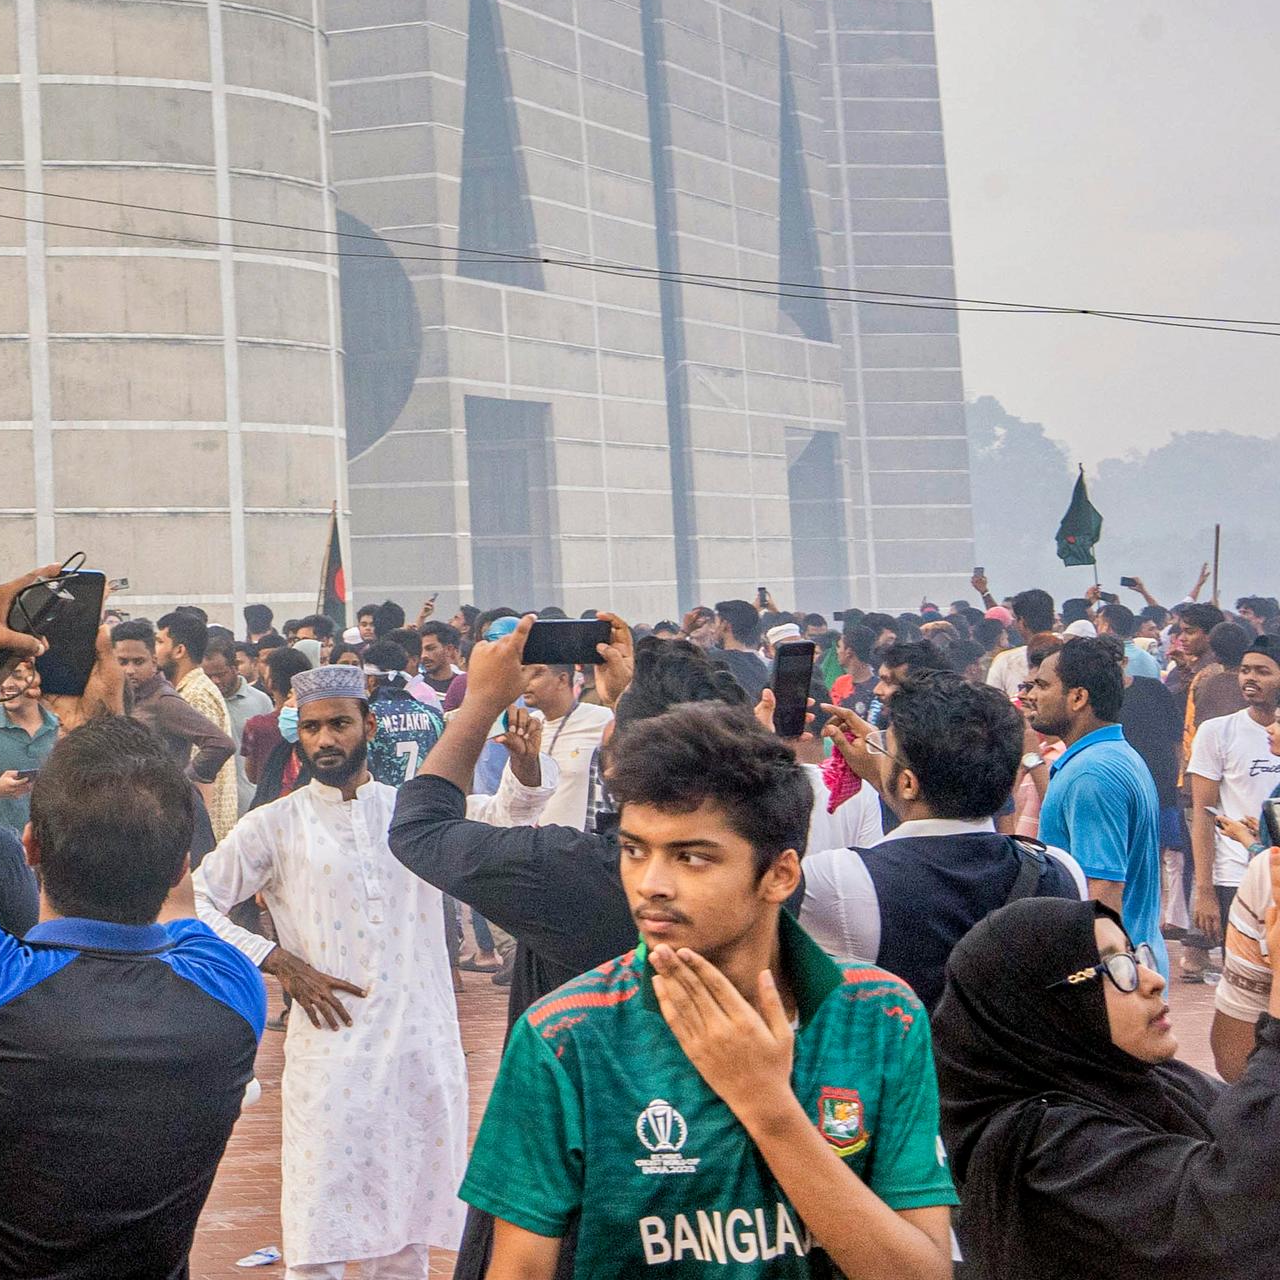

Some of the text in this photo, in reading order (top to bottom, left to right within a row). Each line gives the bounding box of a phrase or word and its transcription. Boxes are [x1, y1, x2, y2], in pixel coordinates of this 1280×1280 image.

[399, 712, 431, 732] ZAKIR
[395, 740, 420, 782] 7
[640, 1202, 811, 1265] BANGLA
